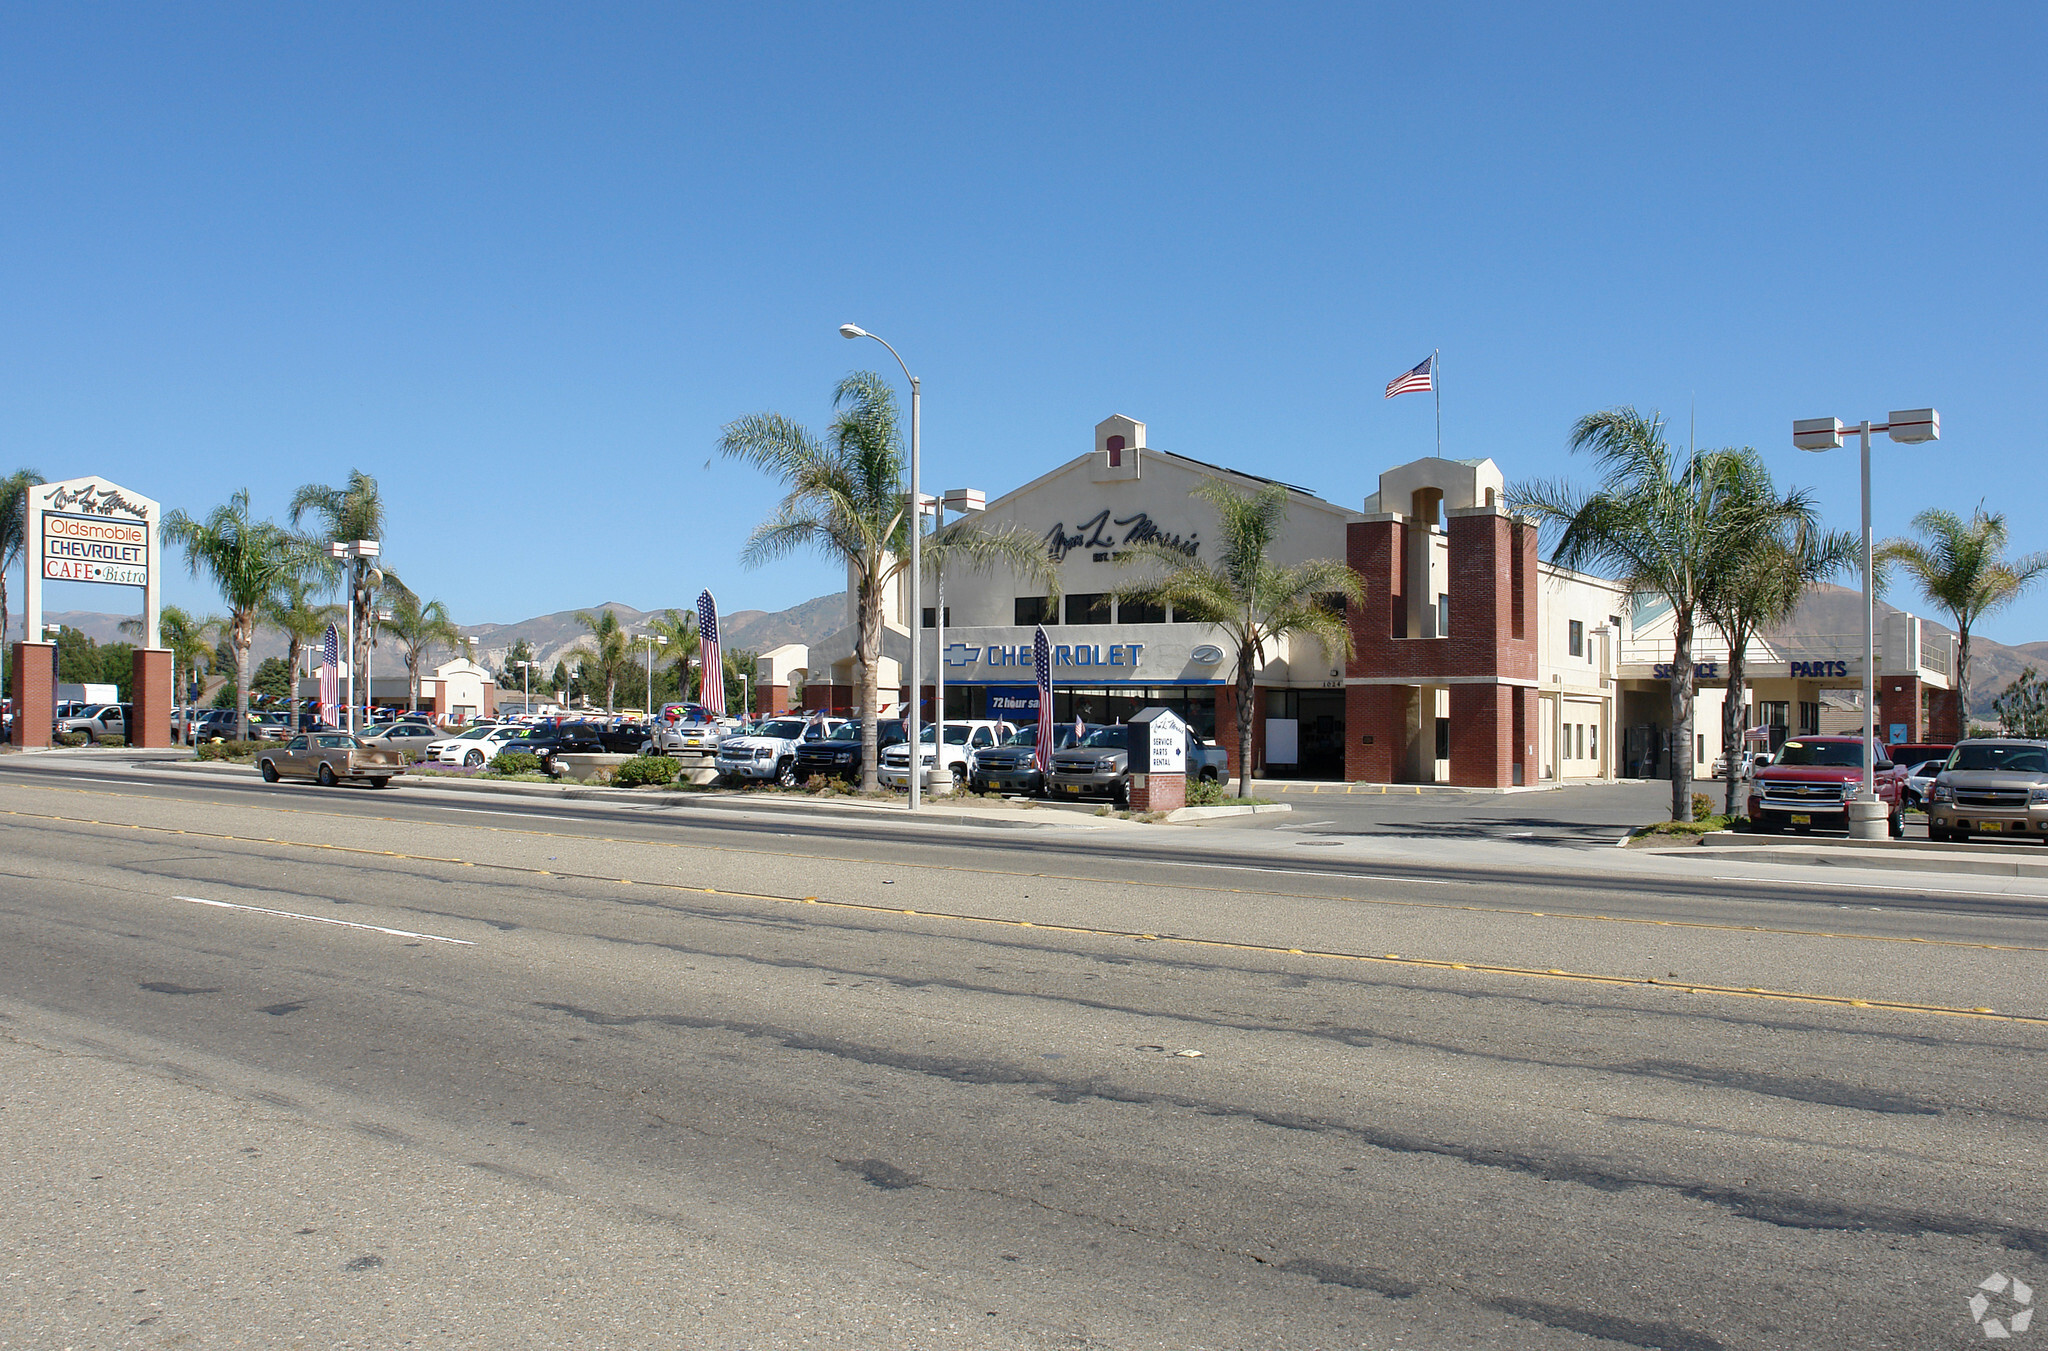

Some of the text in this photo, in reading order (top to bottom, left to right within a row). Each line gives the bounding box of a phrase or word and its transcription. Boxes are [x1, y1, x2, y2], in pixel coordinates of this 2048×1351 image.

[97, 490, 148, 519] Morris
[51, 519, 142, 542] Oldsmobile
[1114, 513, 1200, 557] Morris
[51, 540, 141, 562] CHEVROLET
[47, 560, 146, 584] CAFE Bistro
[988, 644, 1145, 667] CHEROLET
[1653, 663, 1718, 679] SEICE
[1791, 660, 1847, 678] PARTS
[992, 697, 1004, 708] 72
[1004, 696, 1027, 709] hour
[1153, 738, 1172, 746] SERVICE
[1153, 748, 1168, 756] PARTS
[1153, 758, 1170, 766] RENTAL
